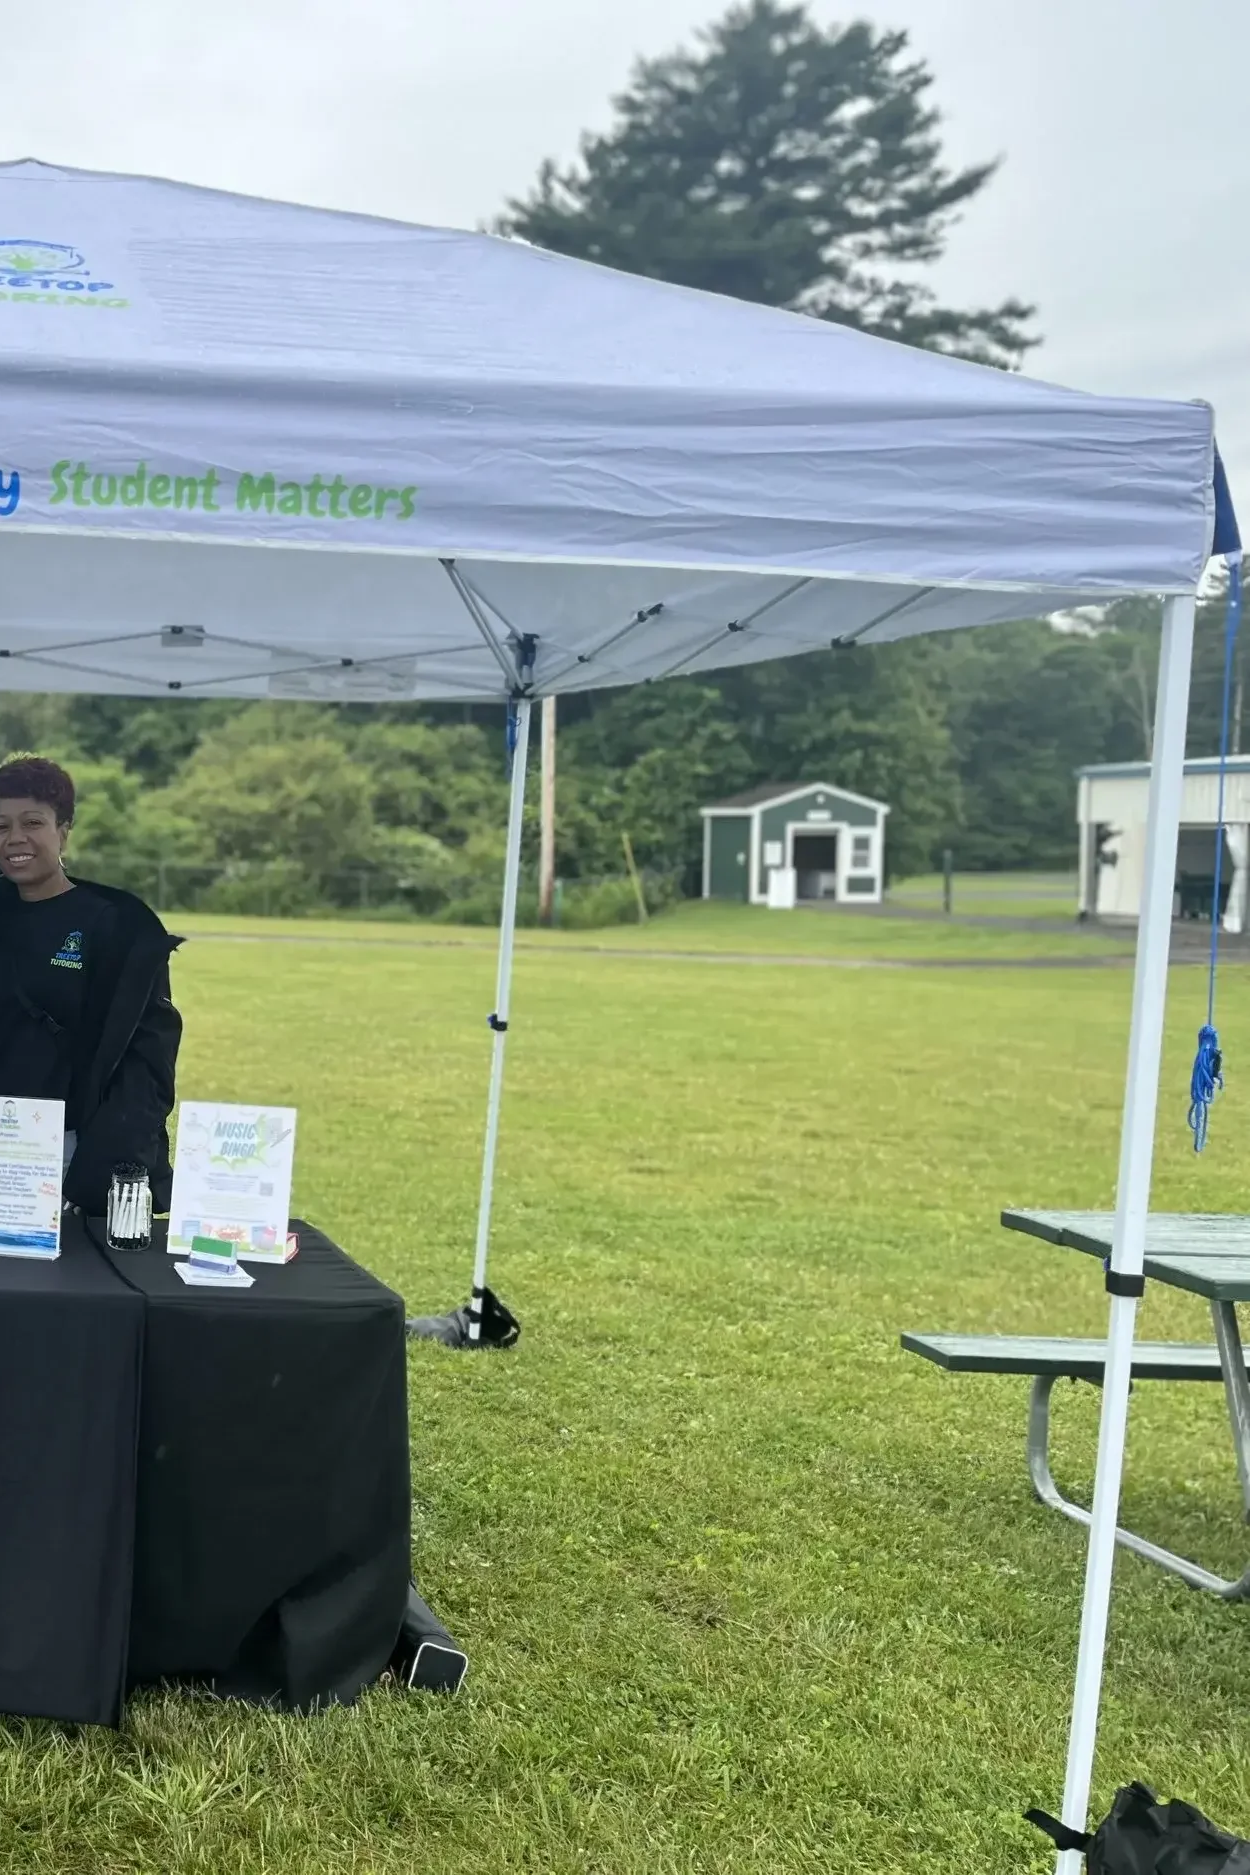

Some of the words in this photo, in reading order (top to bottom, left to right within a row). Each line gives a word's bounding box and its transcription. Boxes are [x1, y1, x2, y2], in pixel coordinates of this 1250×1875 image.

[50, 459, 222, 512] Student
[236, 471, 418, 521] Matters
[50, 958, 83, 970] TUTORING
[214, 1121, 258, 1139] MUSIC
[220, 1141, 258, 1157] BINGO
